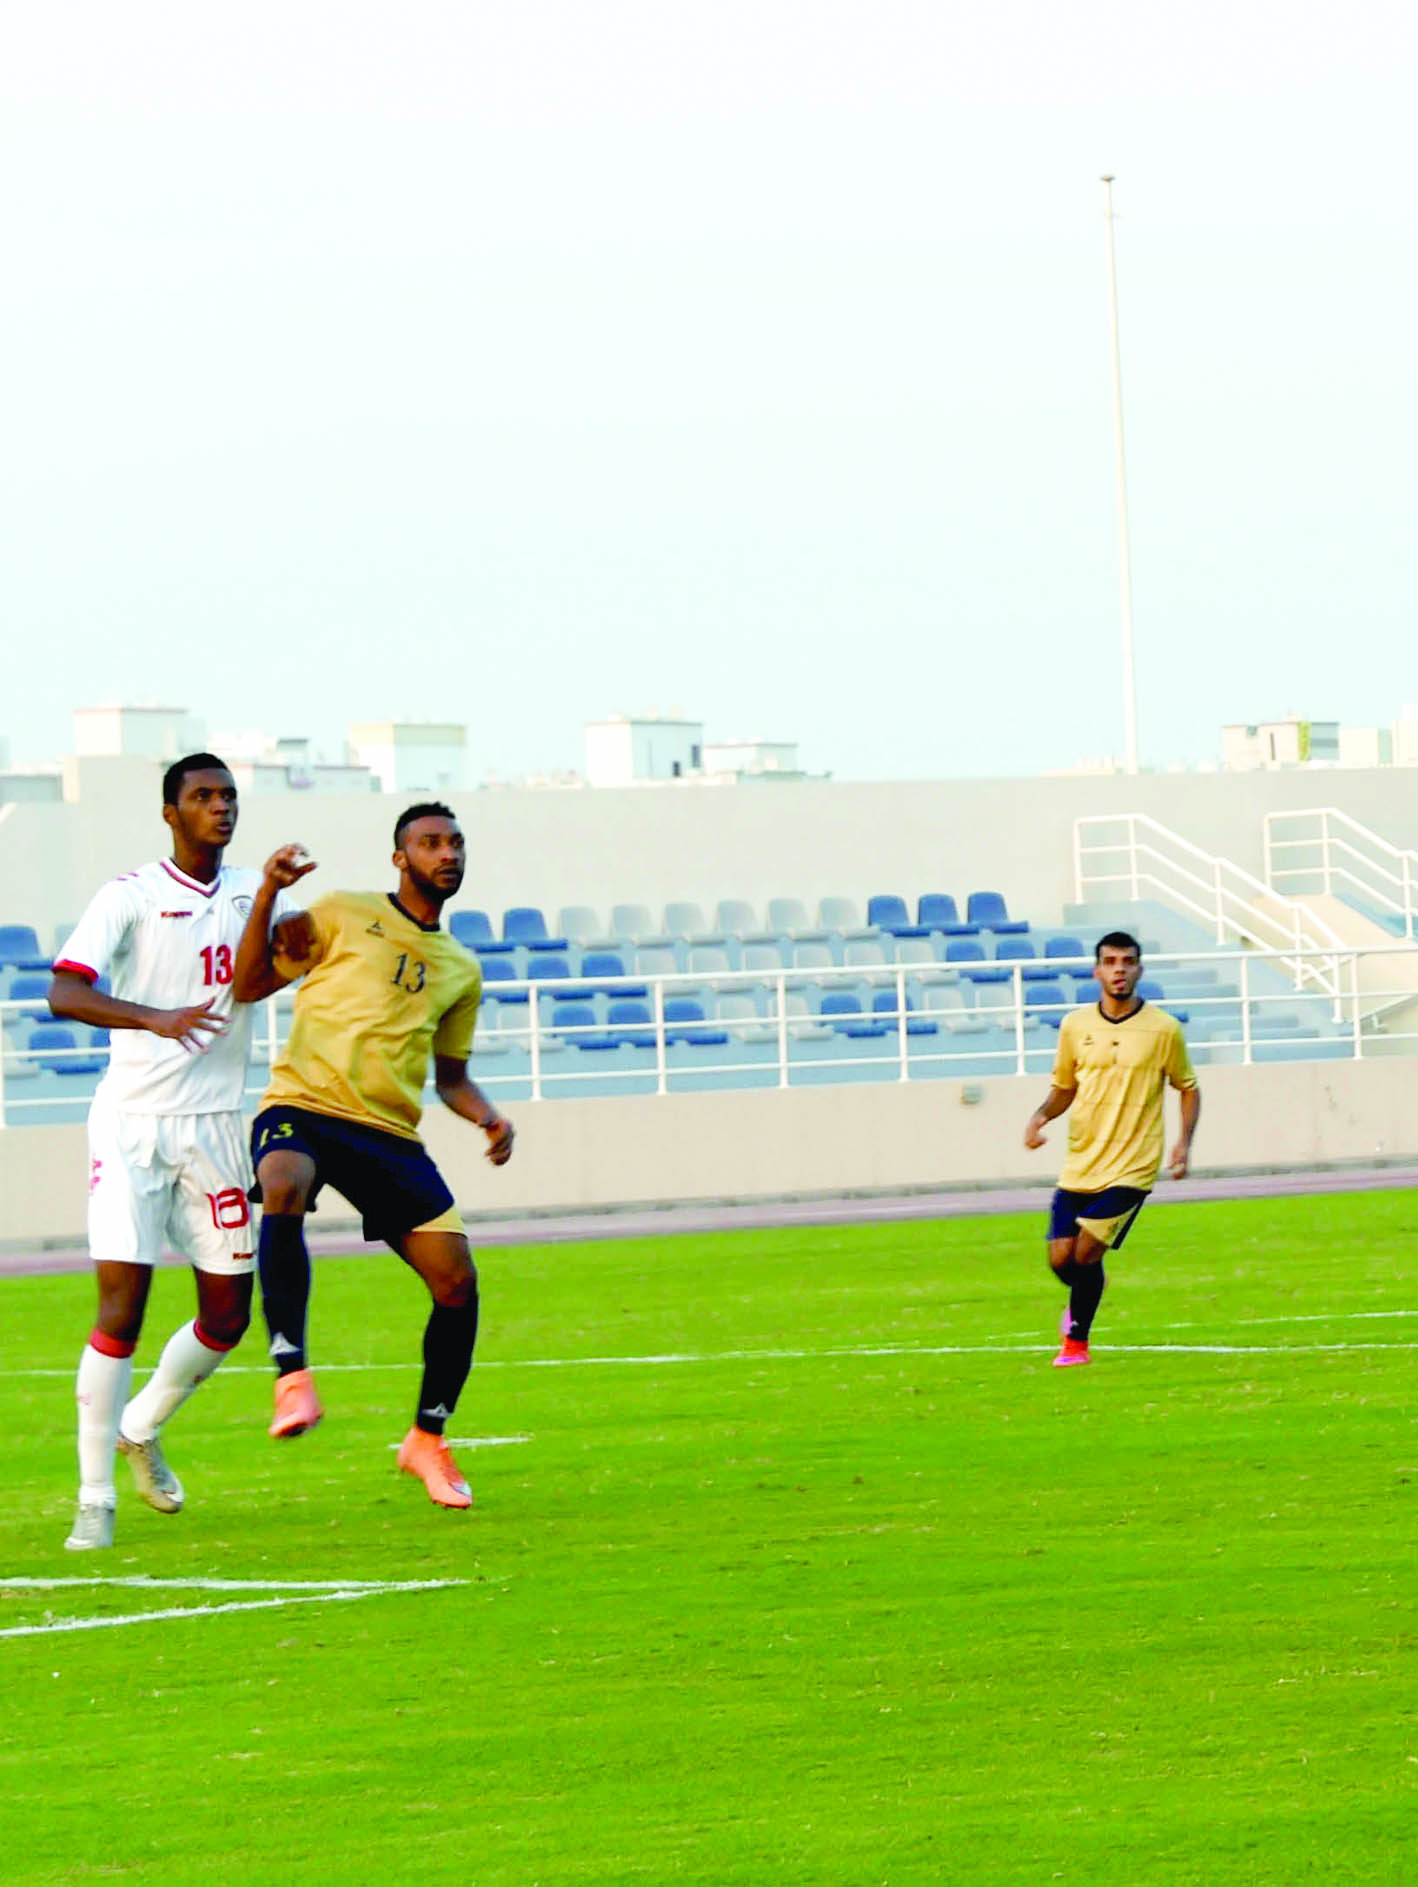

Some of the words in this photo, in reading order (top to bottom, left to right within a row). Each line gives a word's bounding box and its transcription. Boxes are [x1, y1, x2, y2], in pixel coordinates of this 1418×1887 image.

[200, 944, 233, 986] 13
[393, 952, 425, 994] 13
[259, 1122, 294, 1149] 13
